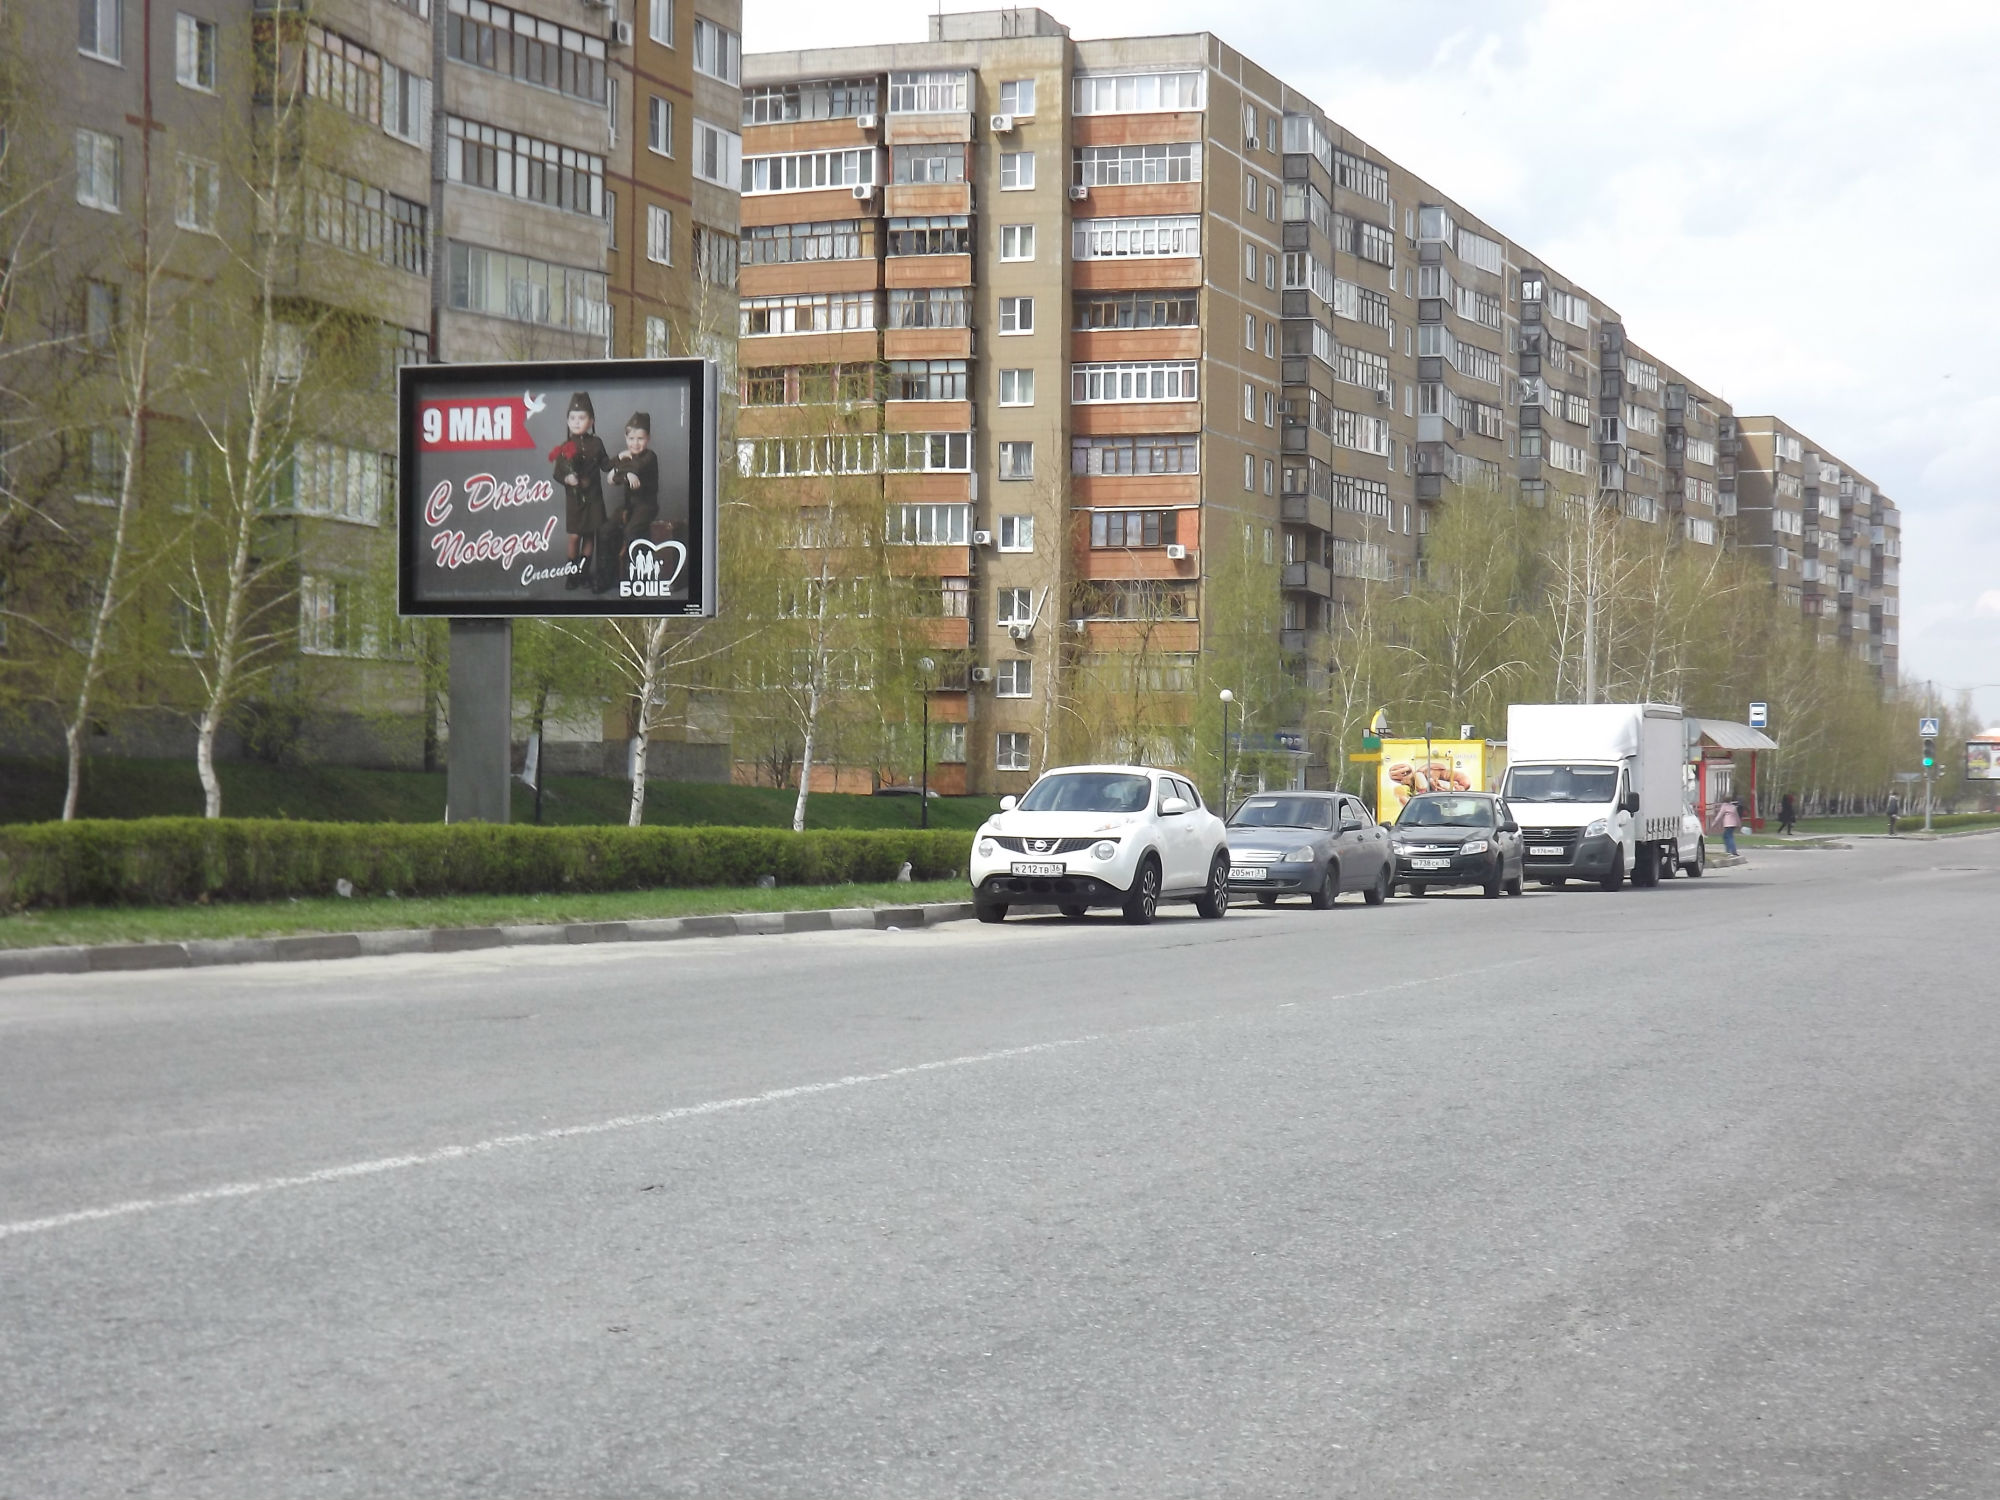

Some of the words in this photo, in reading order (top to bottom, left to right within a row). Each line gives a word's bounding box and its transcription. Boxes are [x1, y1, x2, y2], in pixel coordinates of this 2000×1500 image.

[422, 407, 442, 444] 9
[448, 405, 512, 442] МАЯ
[425, 480, 453, 527] С
[464, 472, 553, 512] Днём
[431, 516, 558, 571] Победы!
[520, 557, 586, 586] Спасибо!
[619, 580, 672, 598] БОШЕ
